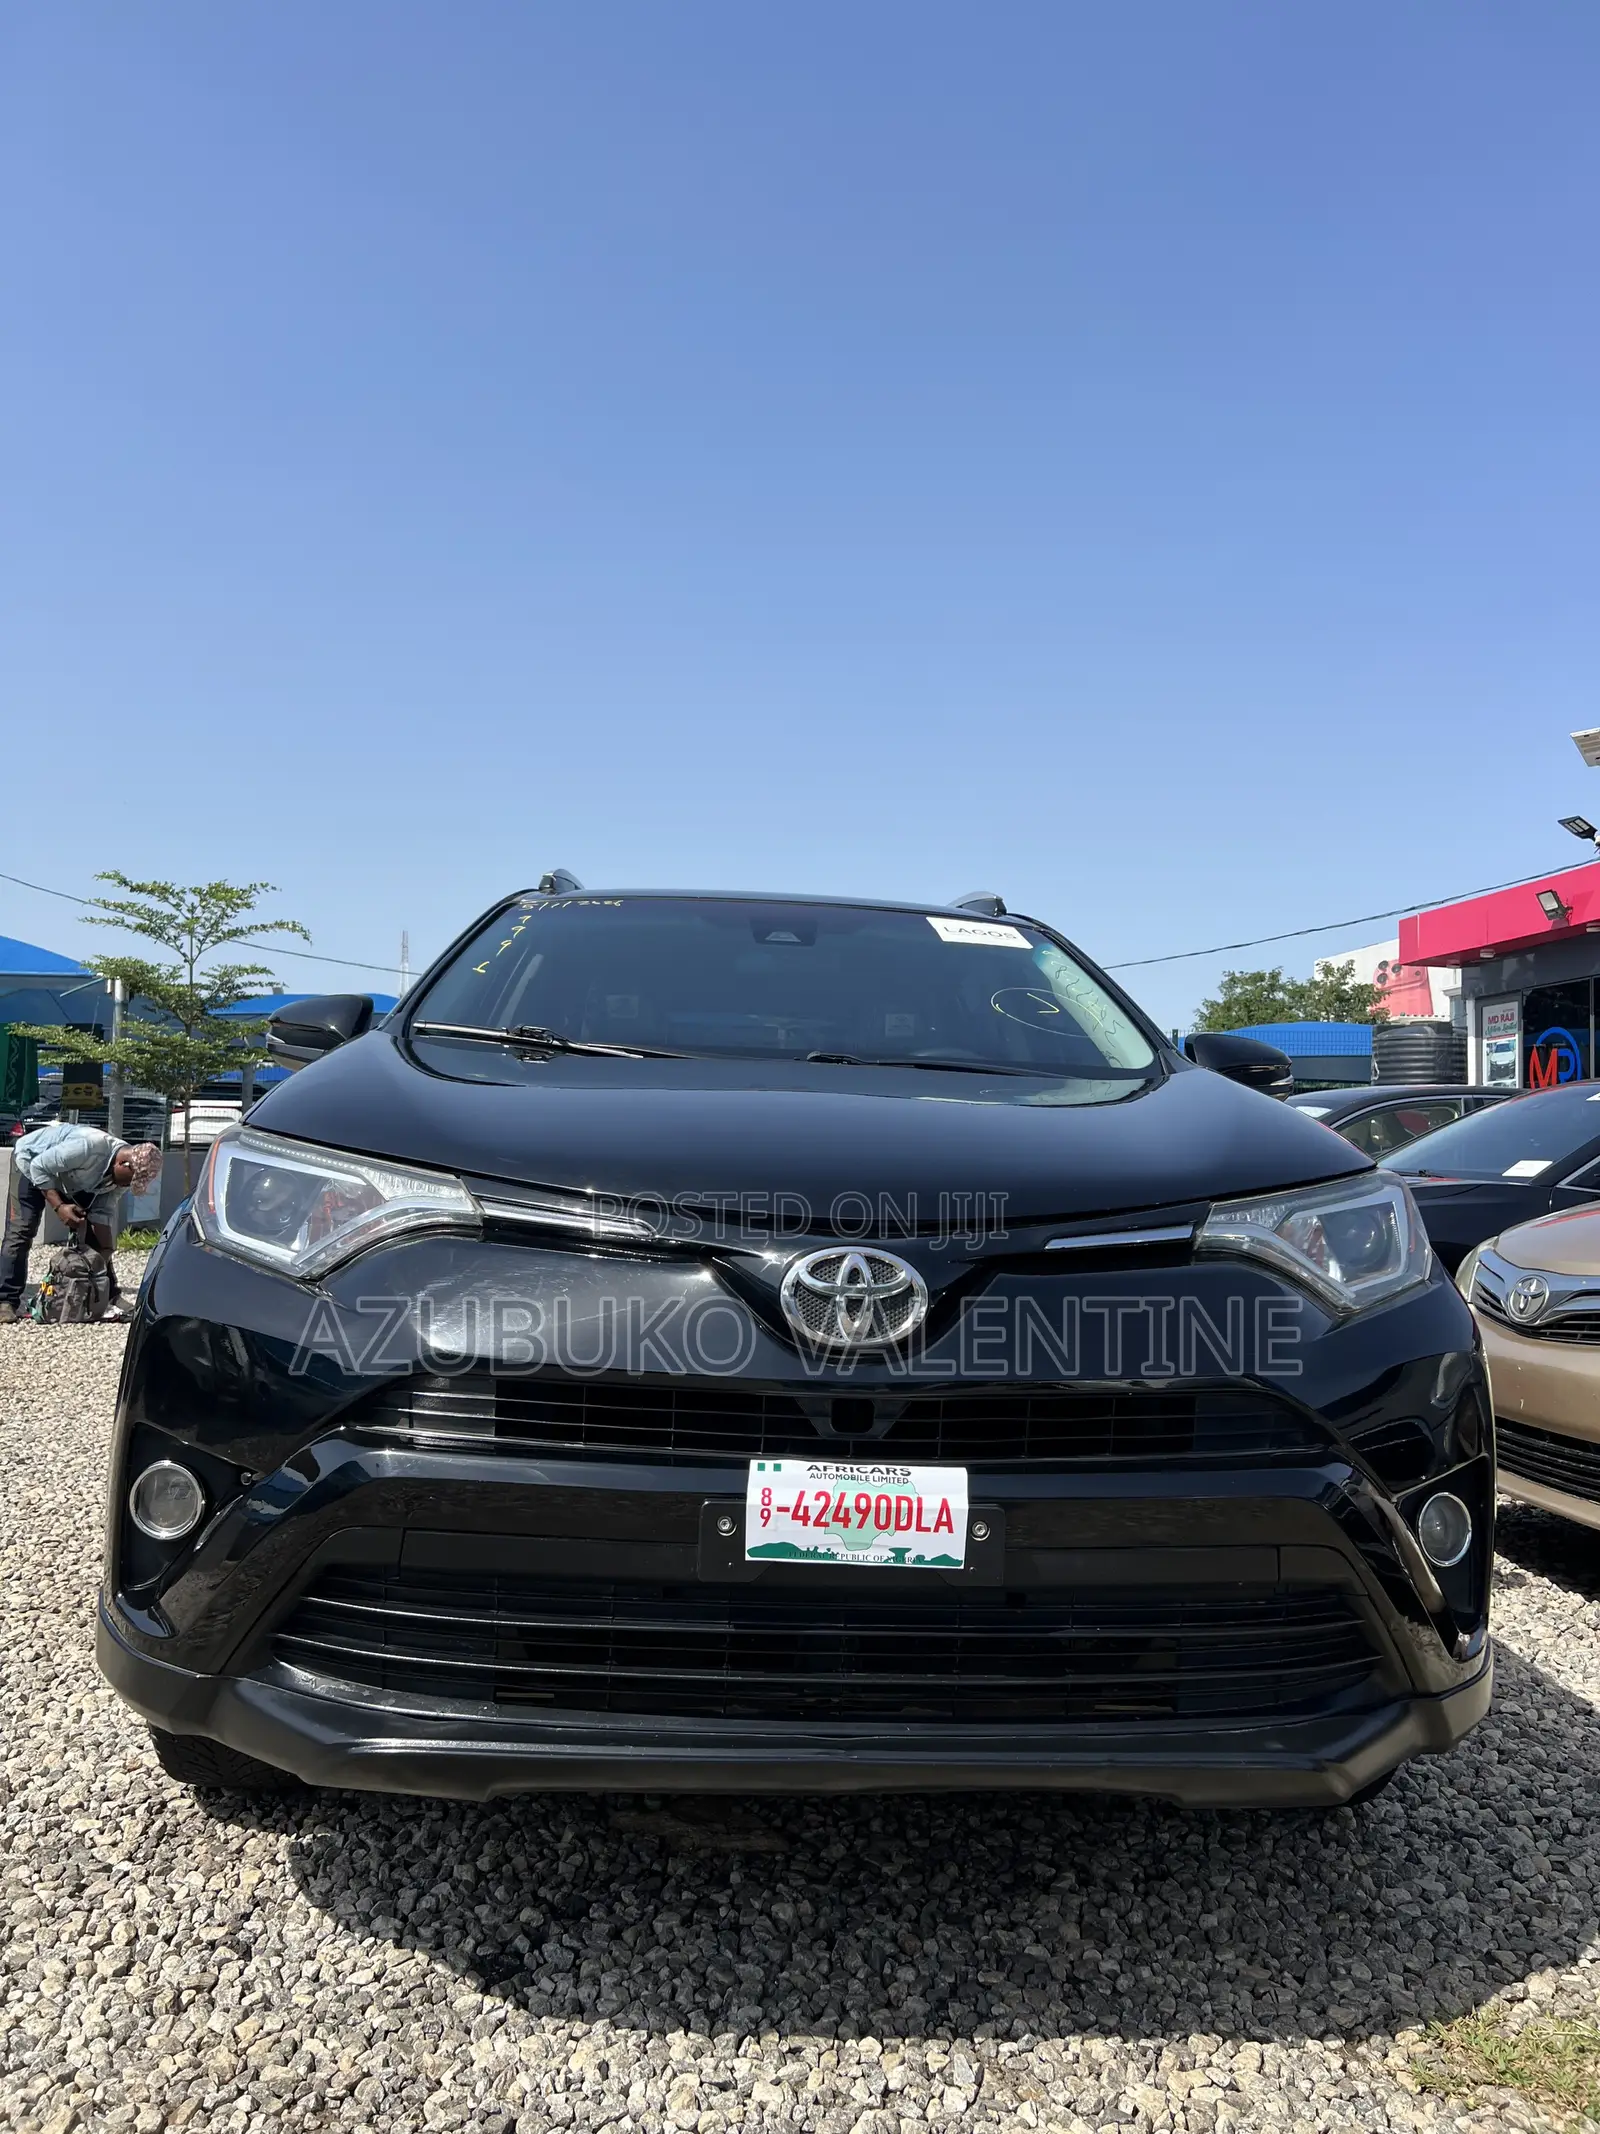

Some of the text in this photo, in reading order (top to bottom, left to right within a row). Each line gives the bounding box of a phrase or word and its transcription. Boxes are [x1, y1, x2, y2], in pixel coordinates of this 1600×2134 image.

[943, 926, 1018, 940] LAGOS
[1487, 1011, 1515, 1025] MD RAJI
[806, 1464, 912, 1477] AFRICARS
[809, 1472, 909, 1485] AUTOMOBILE LIMITED
[829, 1551, 871, 1562] REPUBLIC
[873, 1554, 884, 1563] OF
